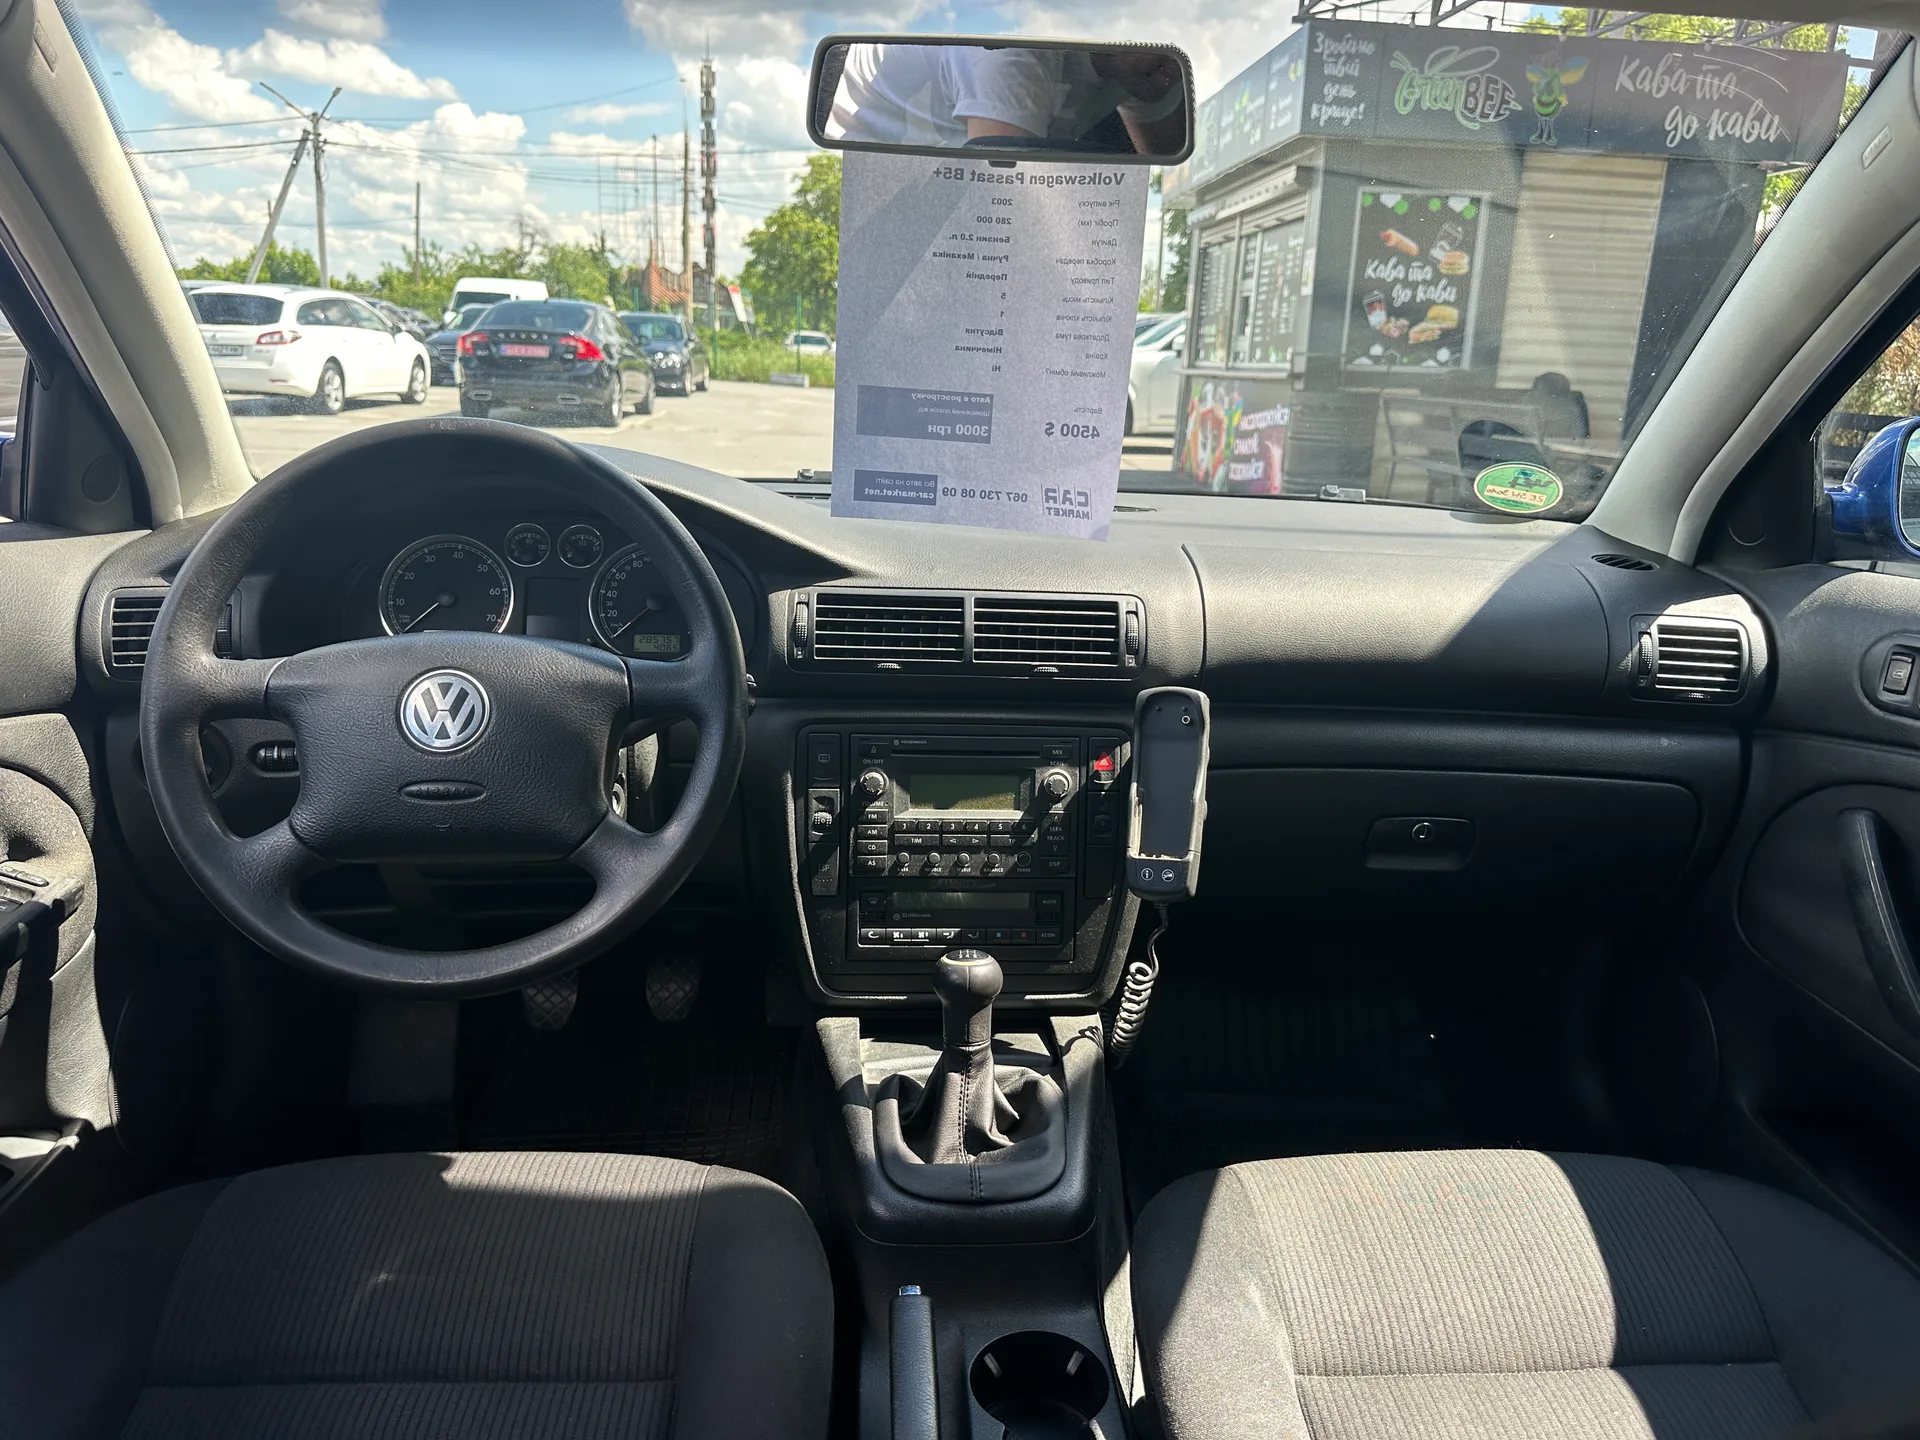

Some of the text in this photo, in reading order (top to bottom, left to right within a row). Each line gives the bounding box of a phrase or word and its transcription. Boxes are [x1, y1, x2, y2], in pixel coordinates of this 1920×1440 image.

[1615, 52, 1739, 100] Кава та
[1664, 99, 1782, 147] до кави
[1364, 255, 1433, 282] Кава та
[1391, 277, 1457, 307] до кави
[425, 555, 436, 563] 30
[452, 551, 464, 559] 40
[632, 560, 643, 568] 80
[404, 572, 415, 580] 20
[615, 572, 626, 580] 60
[485, 614, 496, 622] 70
